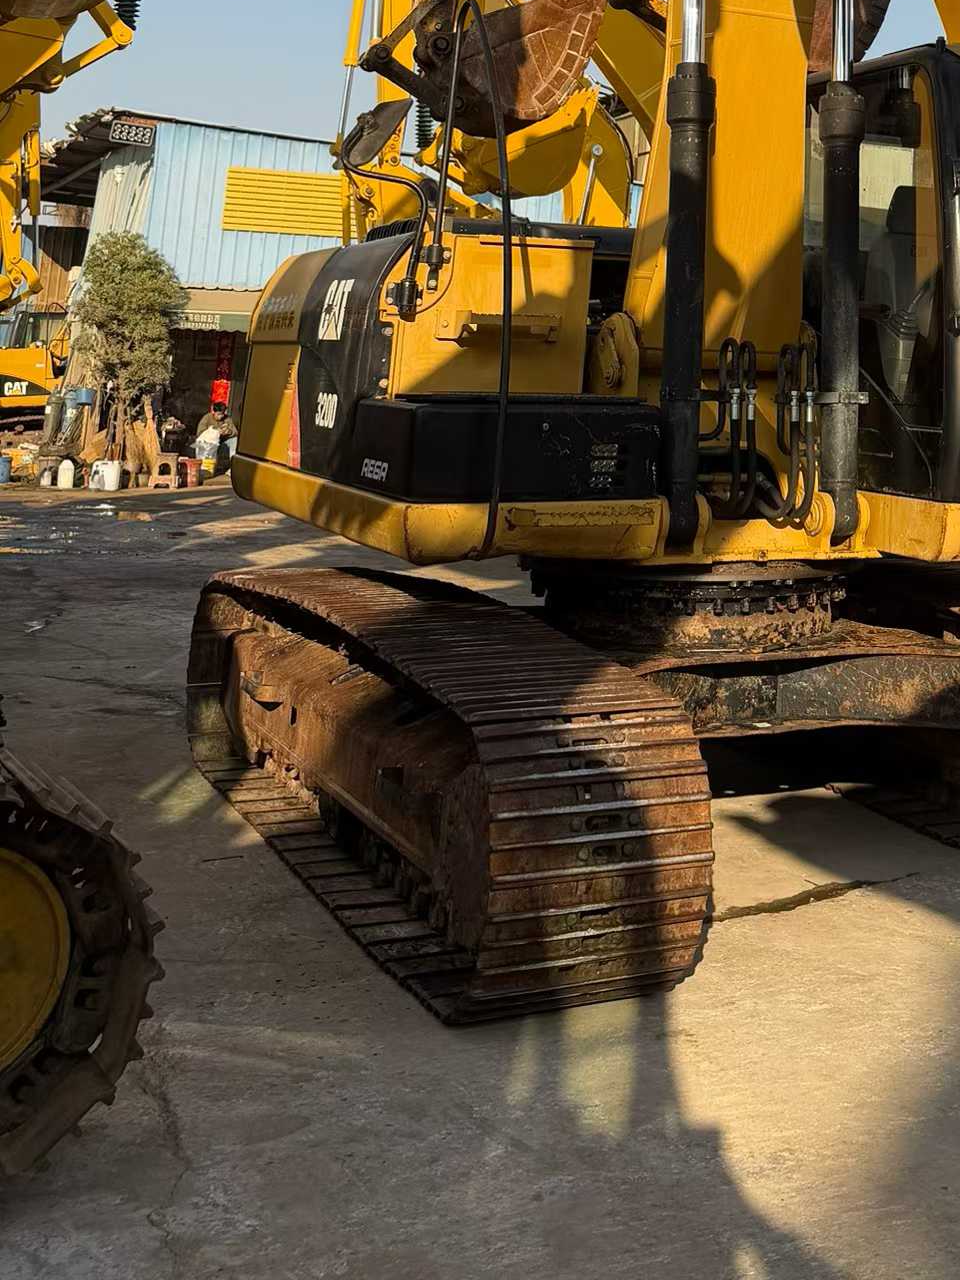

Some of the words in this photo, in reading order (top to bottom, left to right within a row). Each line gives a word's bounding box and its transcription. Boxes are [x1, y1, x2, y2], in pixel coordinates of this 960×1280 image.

[318, 279, 355, 341] CAT
[4, 381, 29, 396] CAT
[315, 392, 338, 429] 320D
